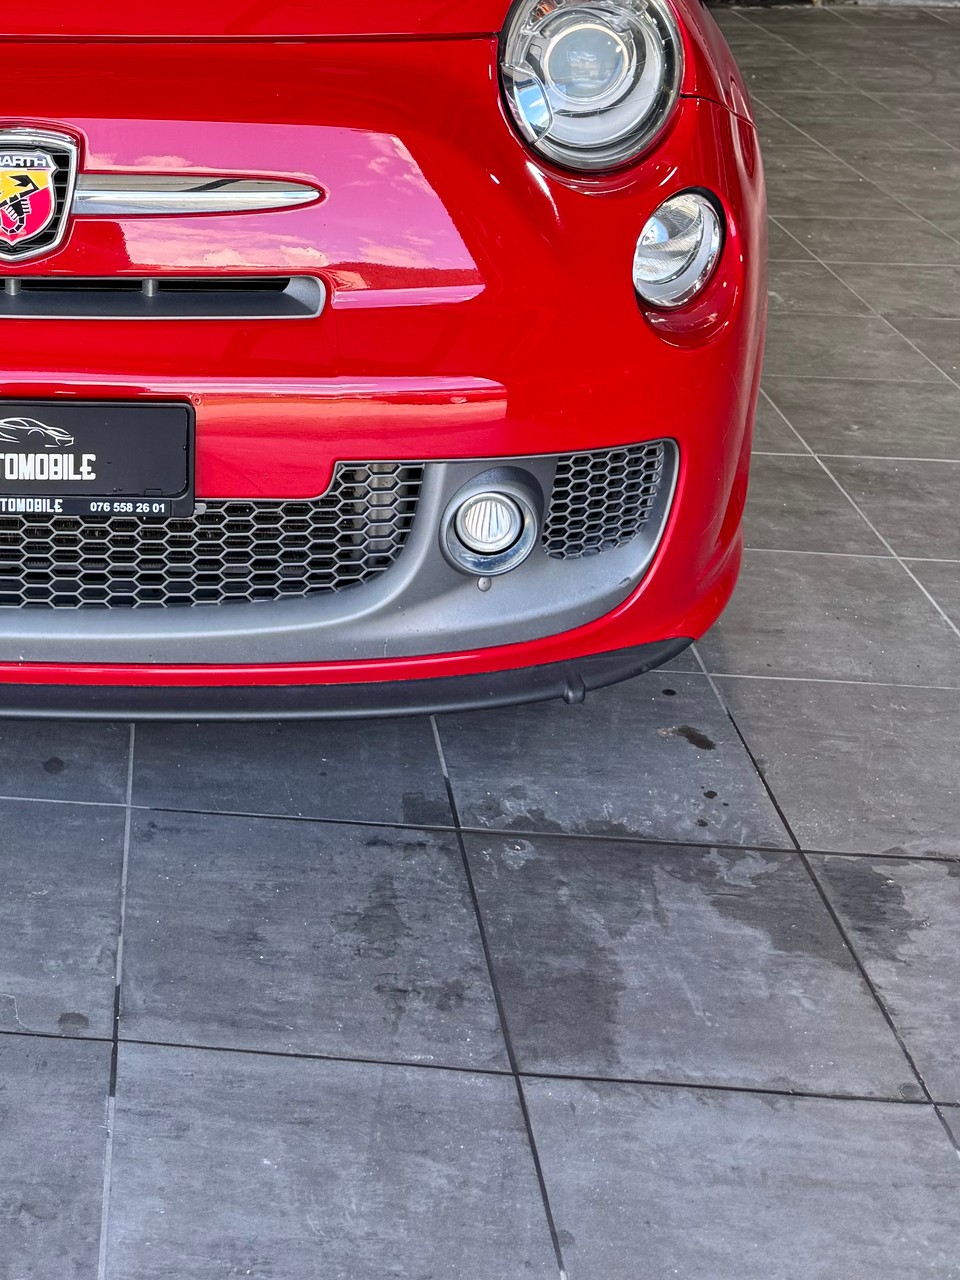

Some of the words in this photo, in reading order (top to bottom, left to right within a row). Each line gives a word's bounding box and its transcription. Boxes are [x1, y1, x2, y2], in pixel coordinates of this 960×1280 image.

[90, 502, 111, 513] 076
[113, 502, 134, 513] 558
[135, 503, 150, 513] 26
[152, 503, 165, 513] 01
